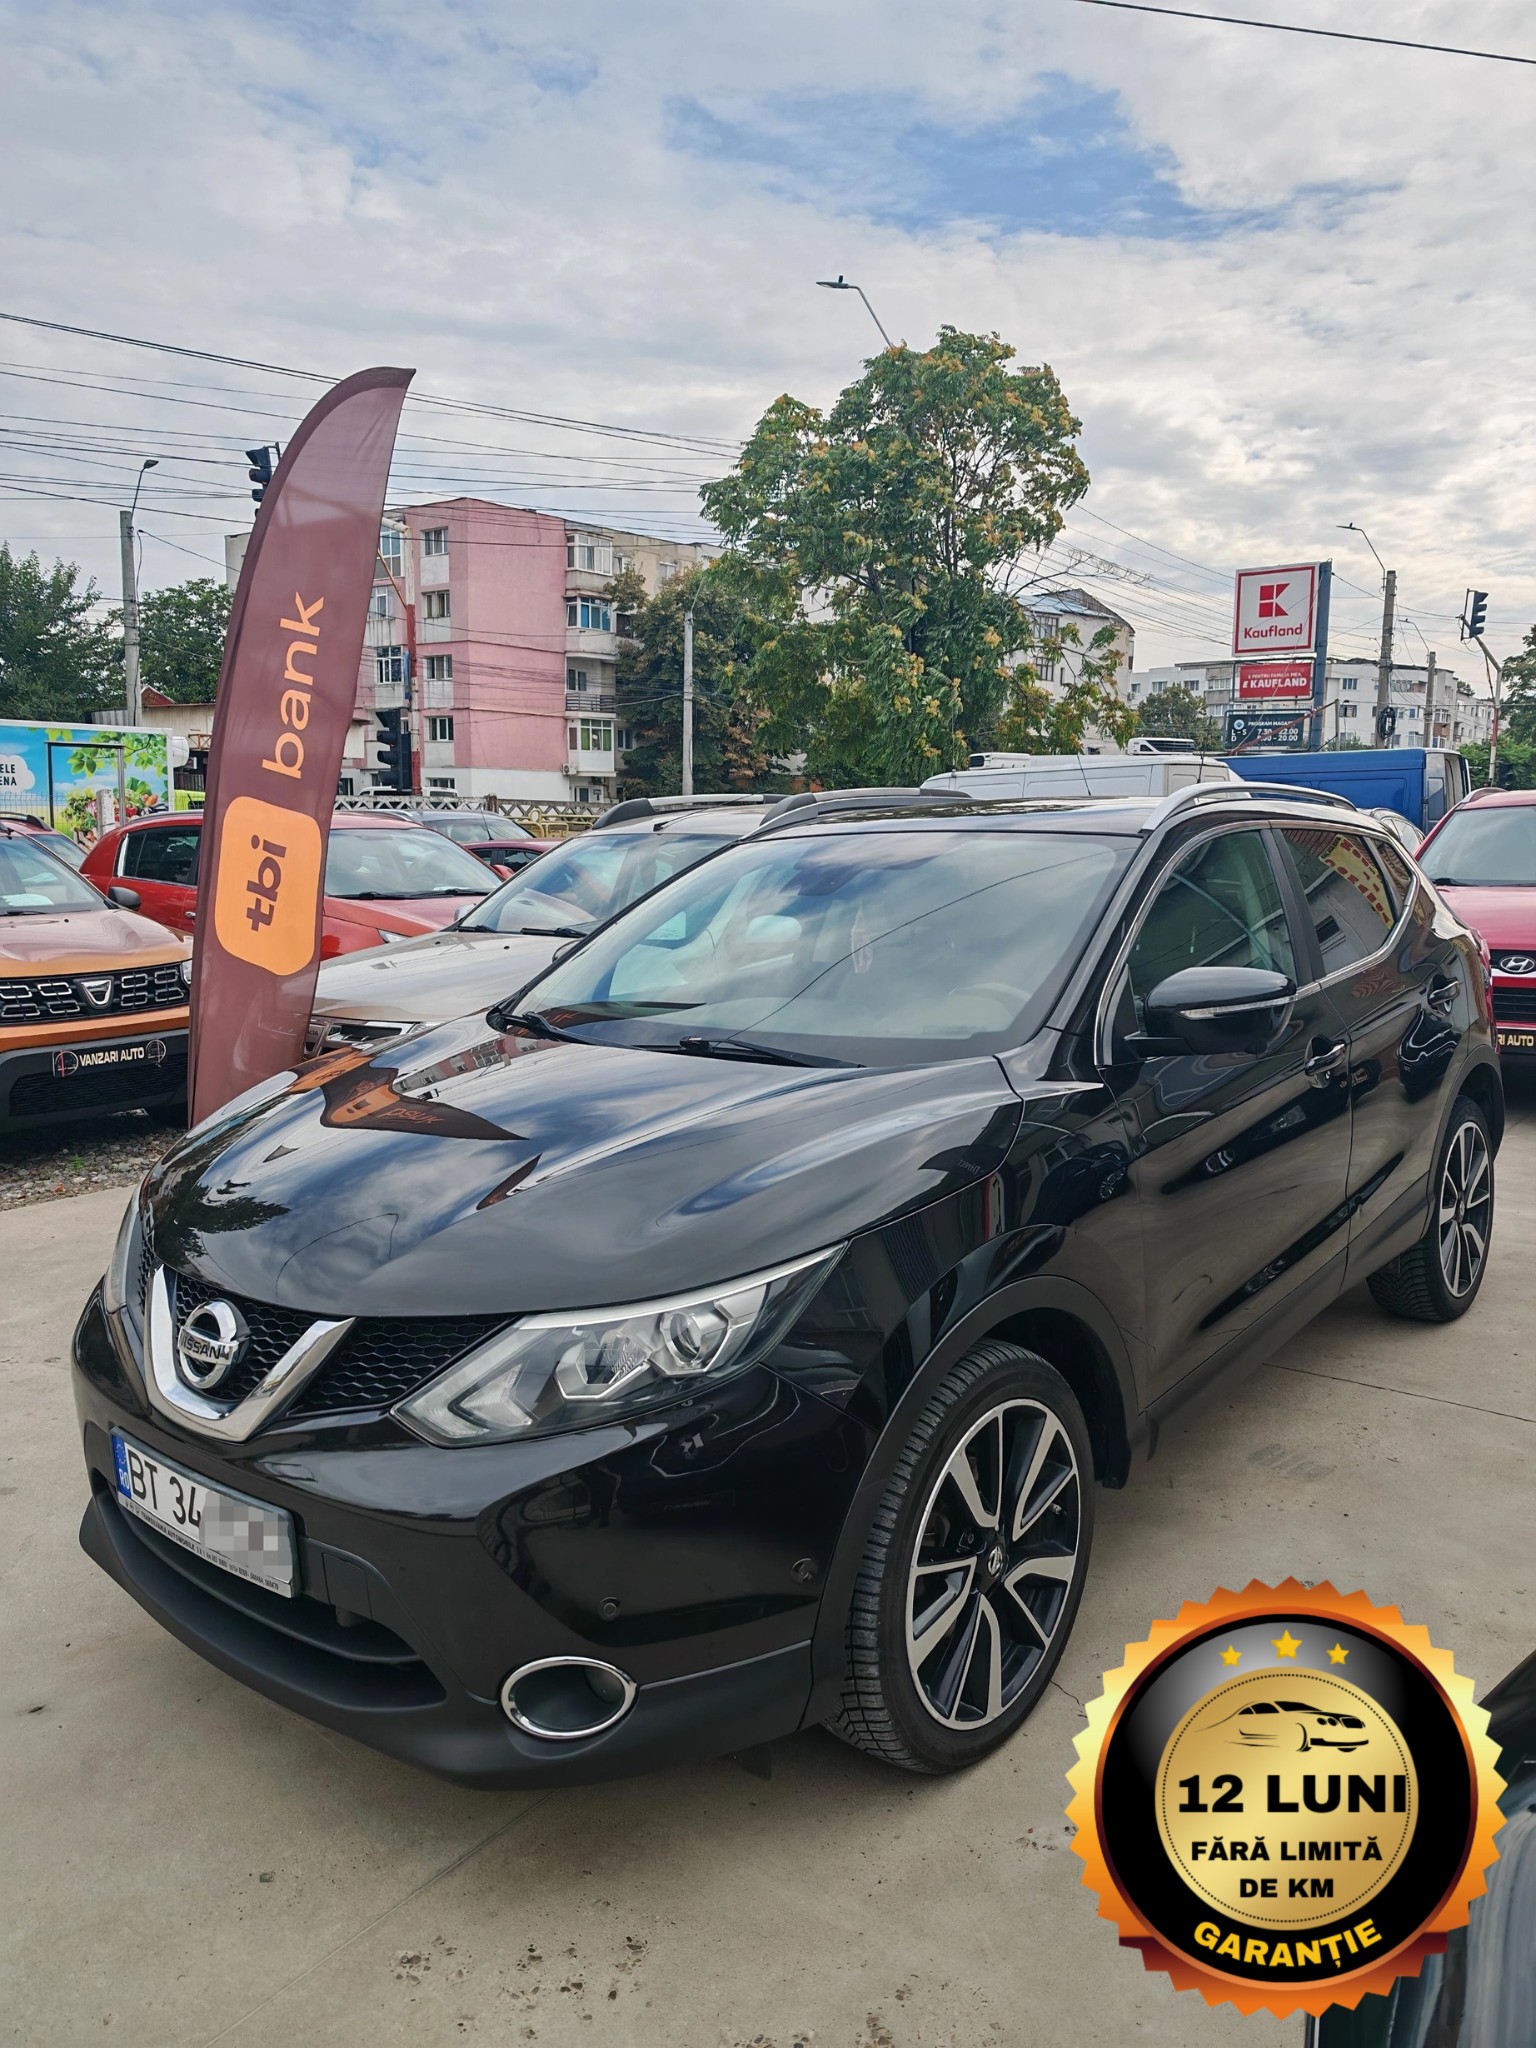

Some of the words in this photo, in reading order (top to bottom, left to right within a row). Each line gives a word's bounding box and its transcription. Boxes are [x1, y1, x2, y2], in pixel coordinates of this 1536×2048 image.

[1244, 623, 1302, 640] Kaufland
[262, 592, 324, 779] bank
[1250, 678, 1307, 688] KAUFLAND
[246, 834, 288, 932] tbi
[1507, 1035, 1534, 1046] AUTO
[79, 1050, 119, 1067] VANZARI
[120, 1047, 145, 1062] AUTO
[180, 1333, 221, 1360] NISSAN
[127, 1448, 159, 1511] BT
